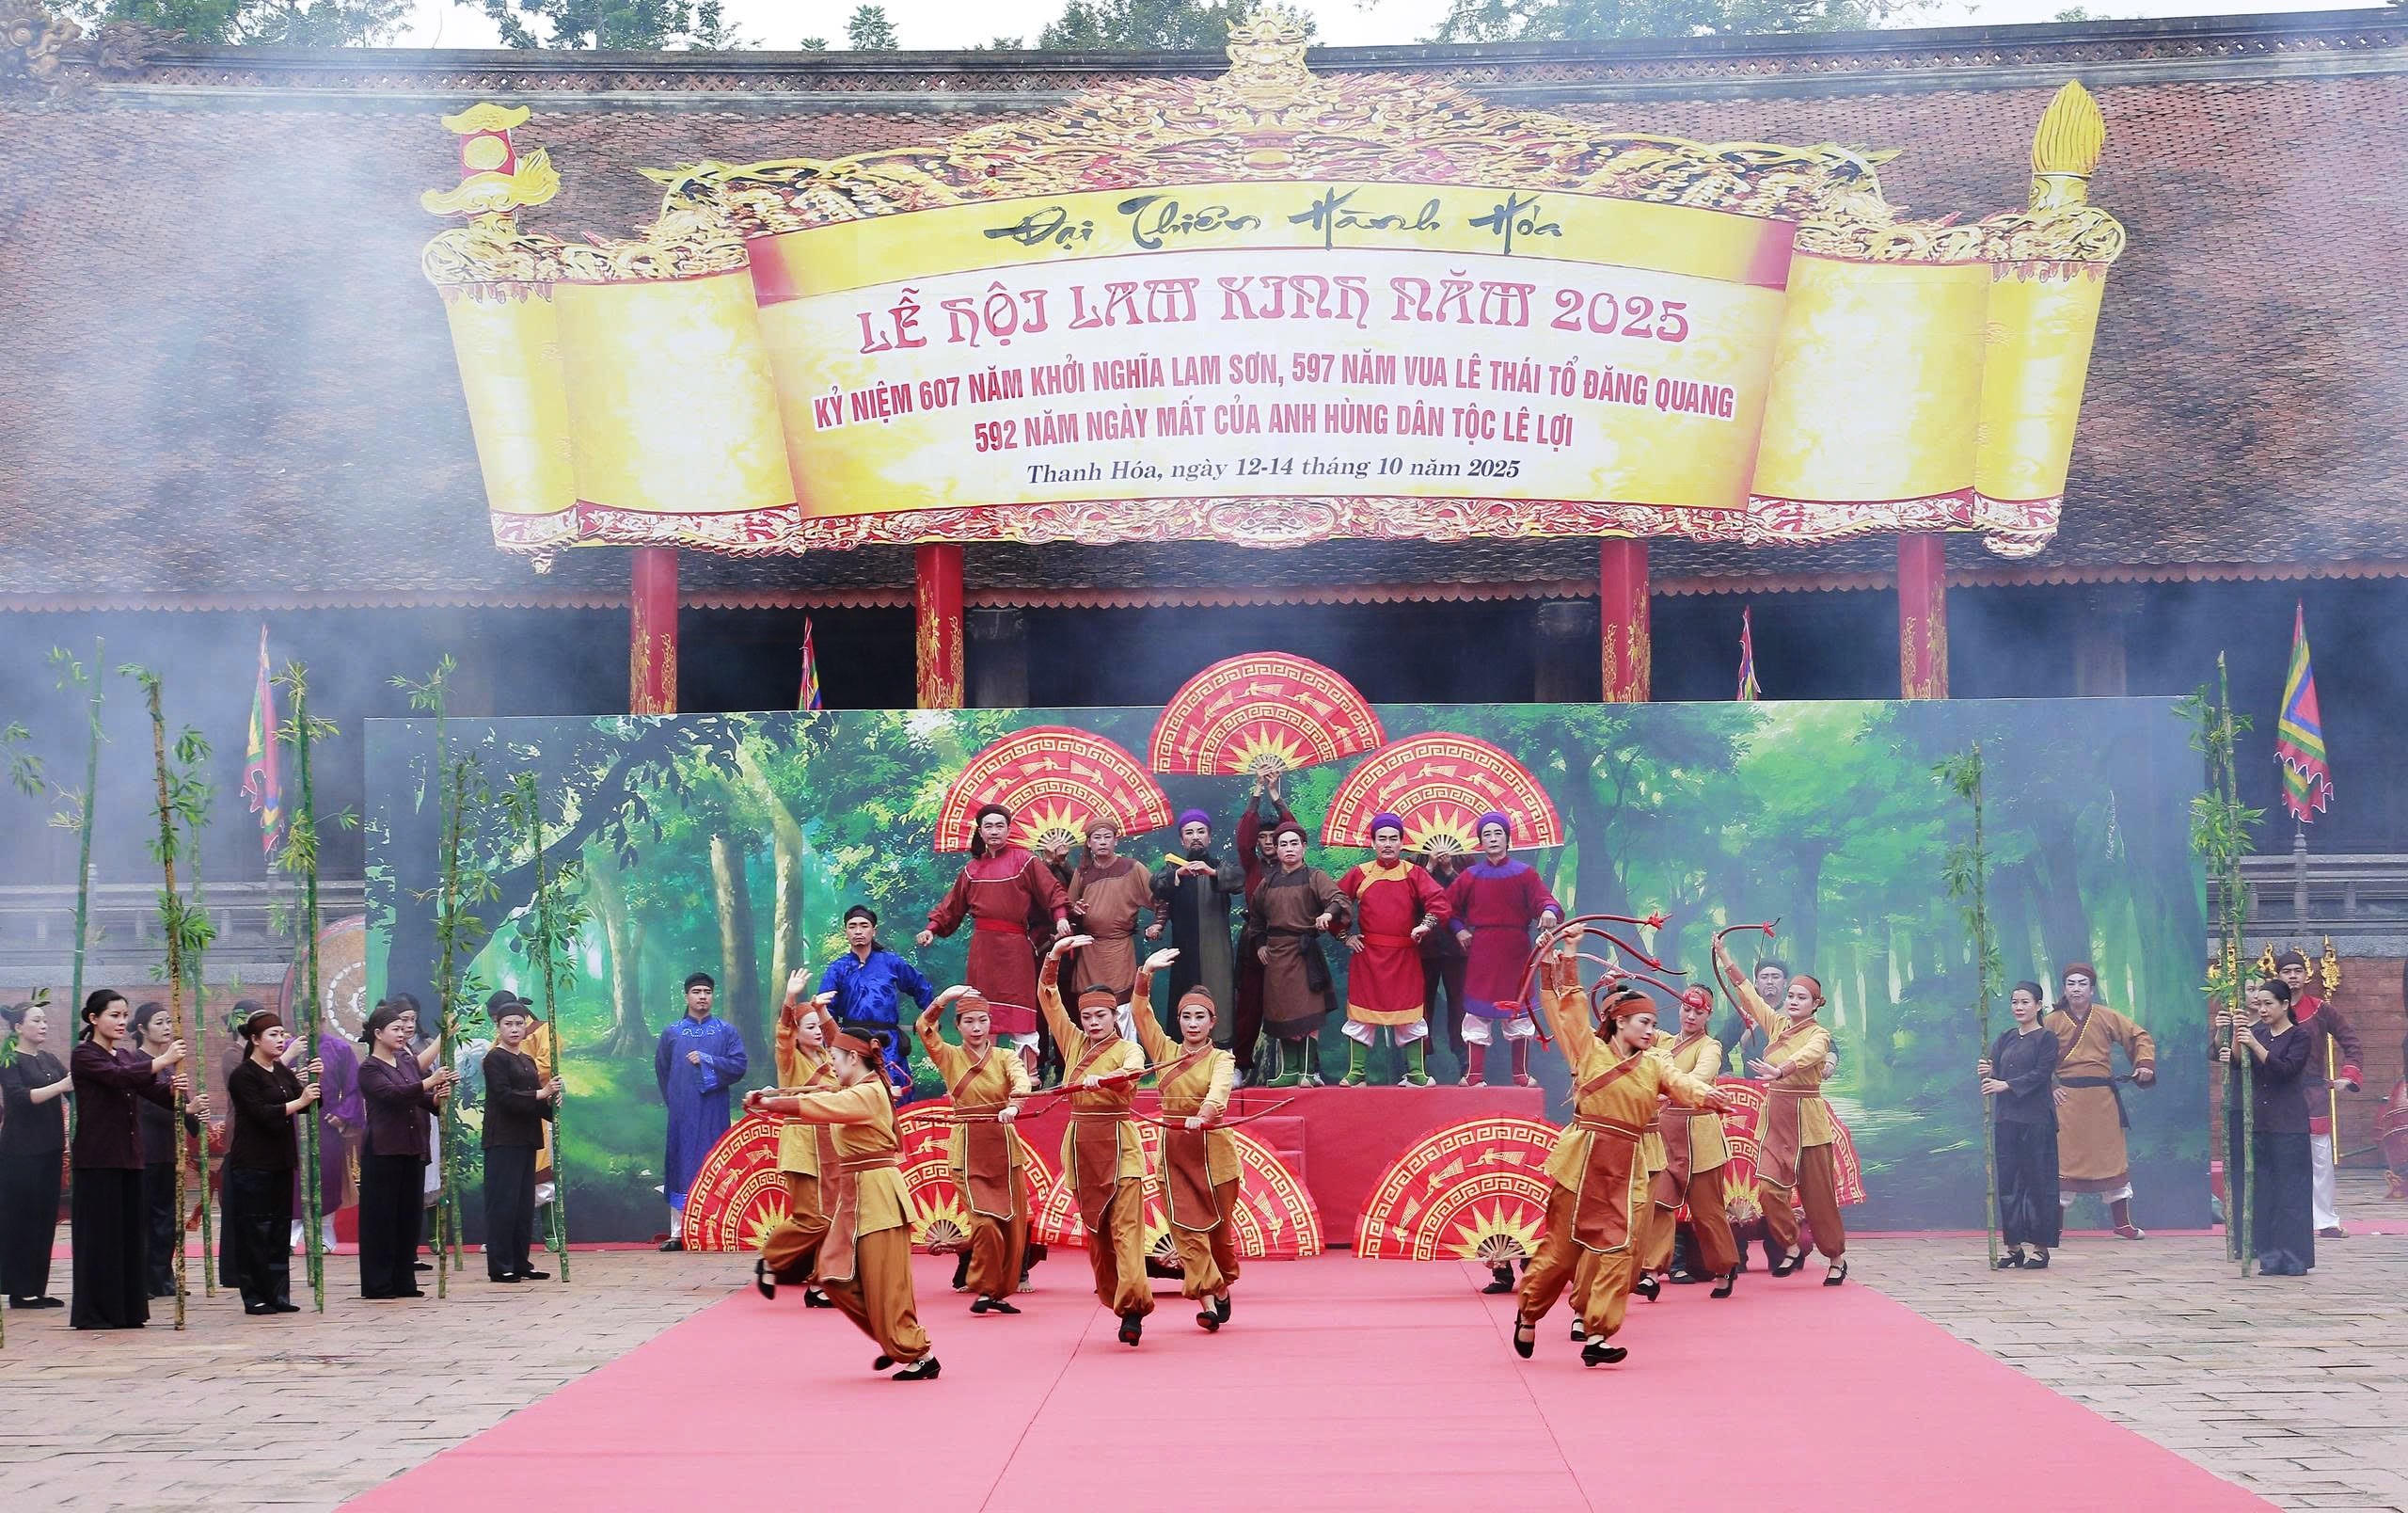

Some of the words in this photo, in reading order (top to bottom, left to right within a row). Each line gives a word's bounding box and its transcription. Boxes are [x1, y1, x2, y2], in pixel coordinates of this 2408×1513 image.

[983, 205, 1094, 250] Đại
[1468, 191, 1562, 256] Hóa
[857, 288, 927, 354] LỄ
[941, 281, 1049, 347] HỘI
[1069, 278, 1199, 329] LAM
[1218, 275, 1370, 329] KINH
[1390, 269, 1536, 326] NĂM
[1550, 289, 1688, 342] 2025
[815, 386, 846, 428] KỶ
[851, 381, 912, 423] NIỆM
[919, 376, 959, 410] 607
[969, 365, 1023, 403] NĂM
[1031, 354, 1085, 397] KHỞI
[1093, 353, 1164, 390] NGHĨA
[1172, 355, 1221, 386] LAM
[1229, 352, 1283, 389] SƠN,
[1291, 353, 1336, 384] 597
[1341, 348, 1396, 385] NĂM
[1404, 356, 1448, 388] VUA
[1455, 351, 1481, 390] LÊ
[1490, 351, 1542, 393] THÁI
[1548, 355, 1579, 397] TỔ
[1583, 365, 1648, 405] ĐĂNG
[1655, 378, 1735, 419] QUANG
[974, 421, 1018, 453] 592
[1024, 409, 1078, 448] NĂM
[1086, 406, 1148, 441] NGÀY
[1156, 394, 1207, 437] MẤT
[1213, 393, 1261, 435] CỦA
[1268, 404, 1316, 434] ANH
[1324, 400, 1388, 435] HÙNG
[1397, 400, 1445, 437] DÂN
[1452, 408, 1496, 446] TỘC
[1504, 406, 1529, 443] LÊ
[1536, 413, 1573, 452] LỢI
[1028, 463, 1101, 485] Thanh
[1111, 460, 1163, 483] Hóa,
[1170, 458, 1228, 482] ngày
[1236, 458, 1294, 477] 12-14
[1302, 456, 1370, 479] tháng
[1377, 456, 1403, 476] 10
[1410, 458, 1461, 477] năm
[1467, 459, 1520, 478] 2025
